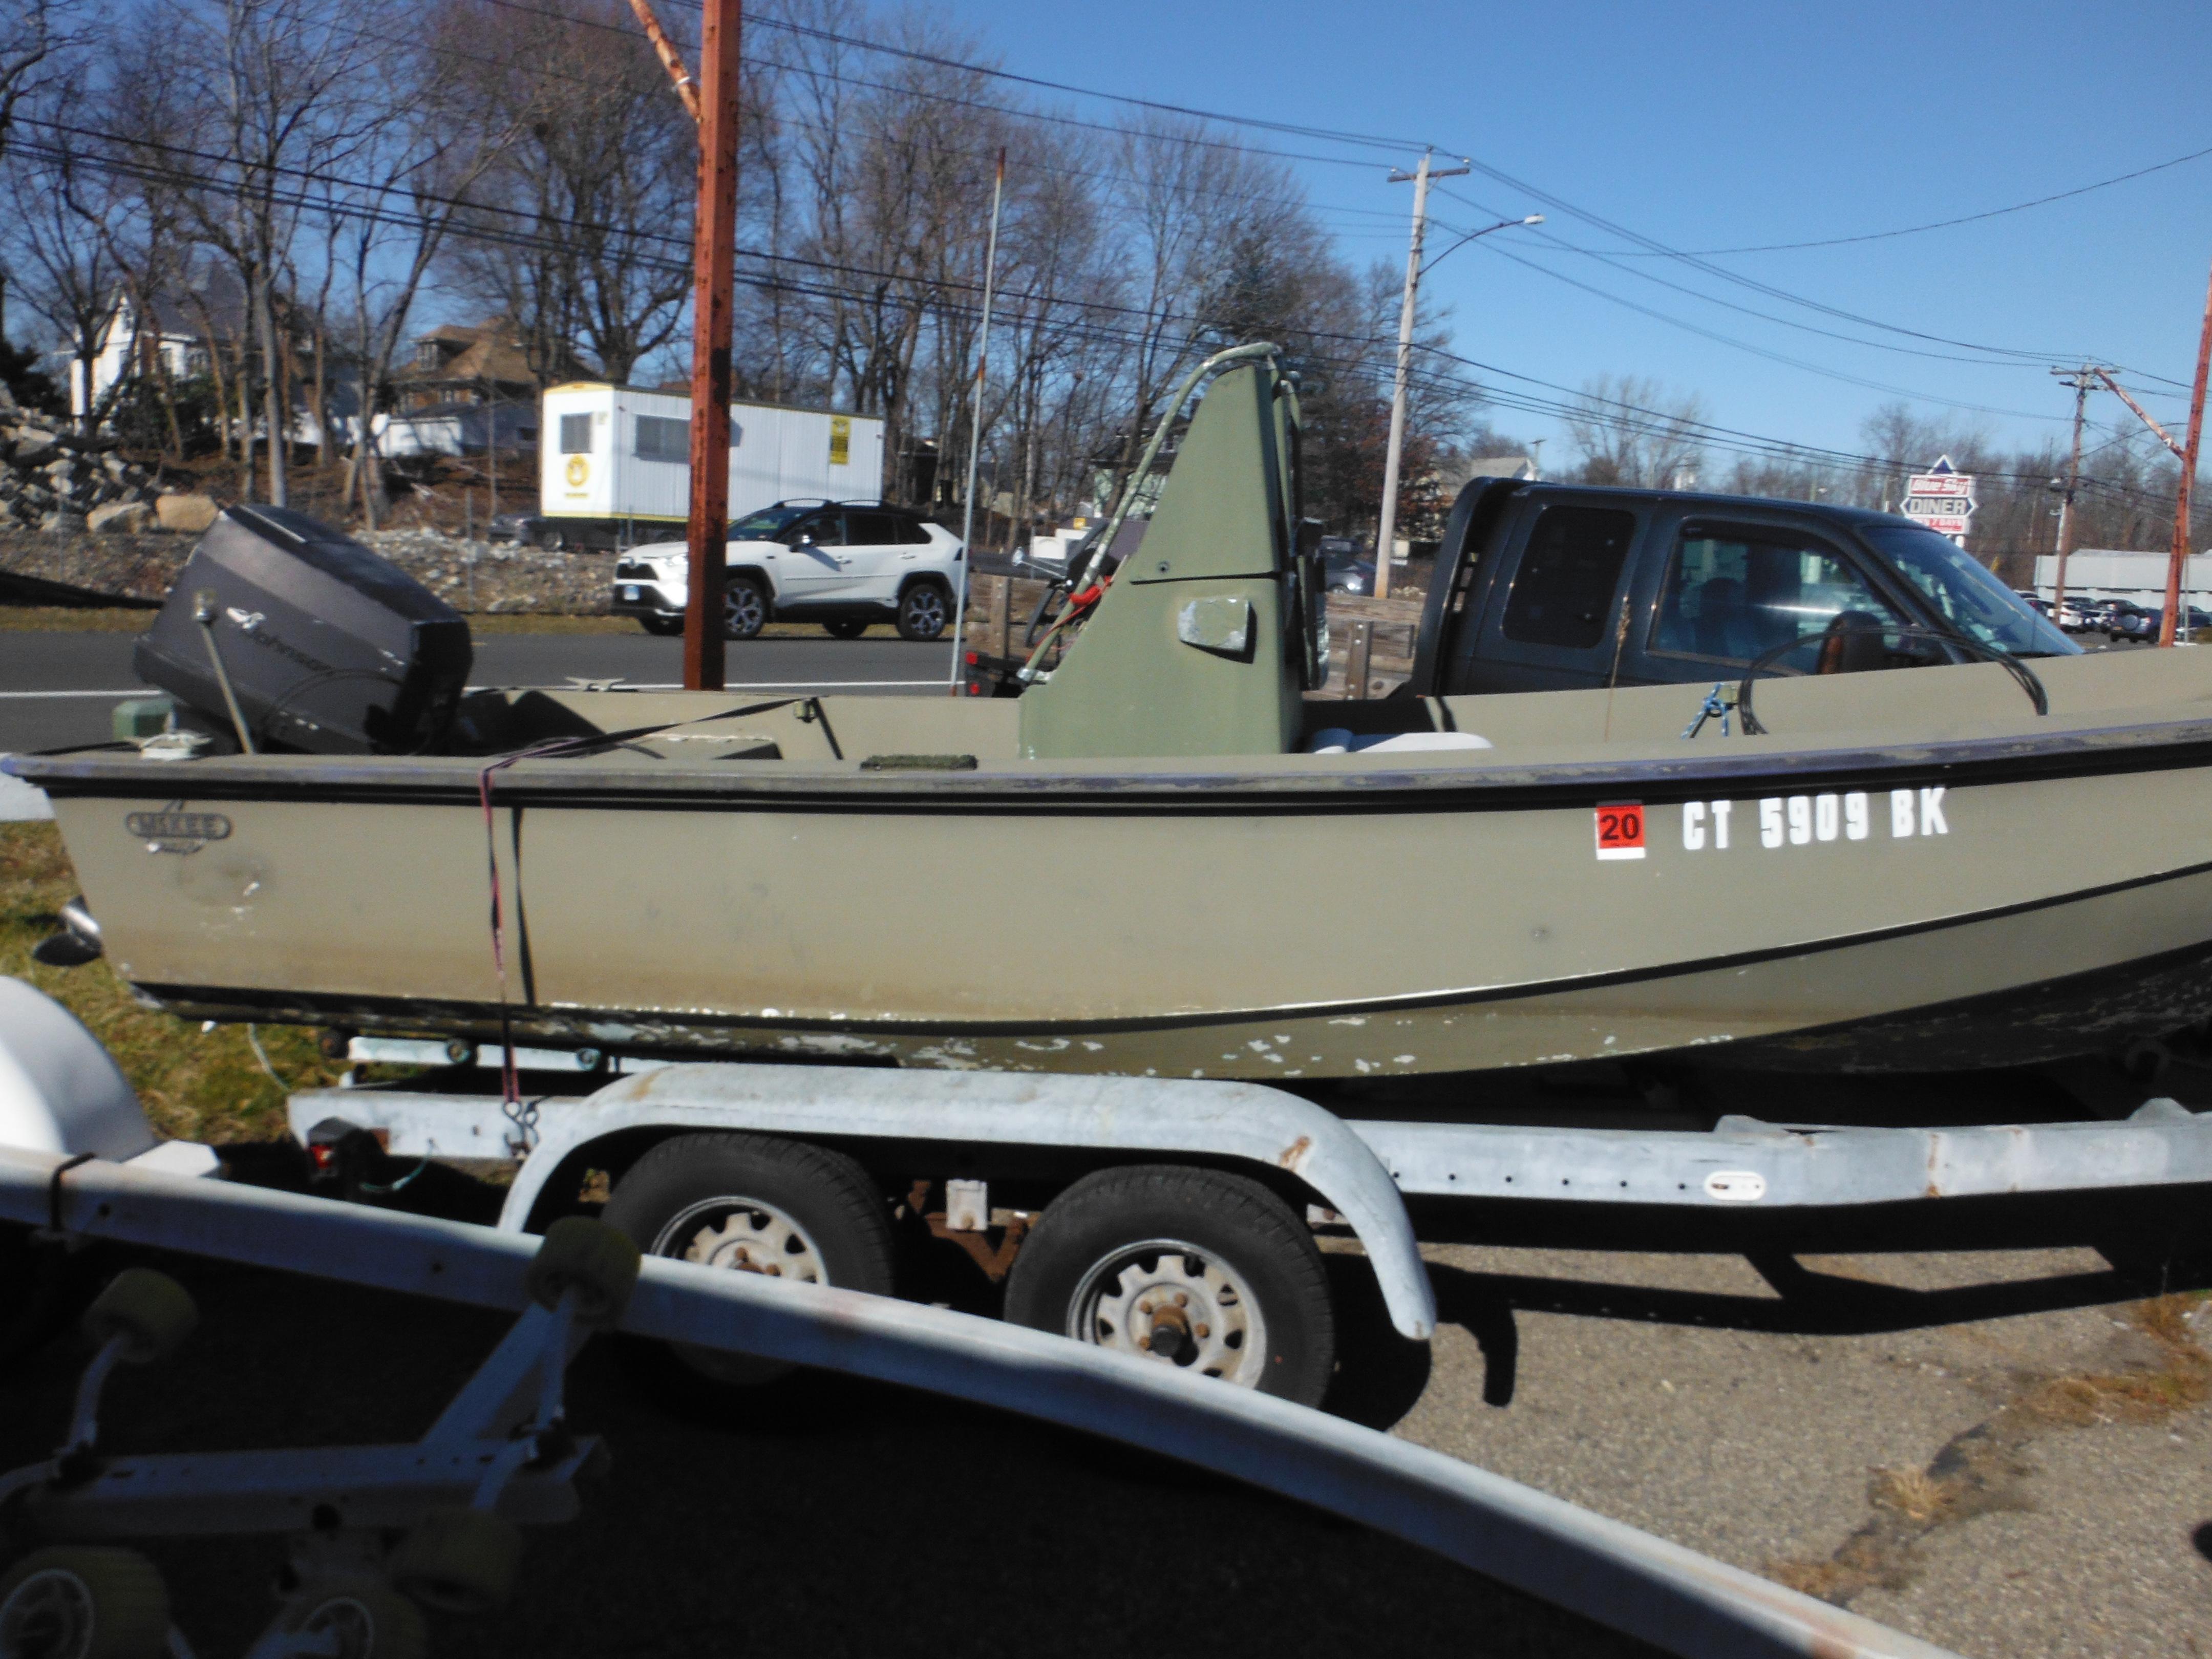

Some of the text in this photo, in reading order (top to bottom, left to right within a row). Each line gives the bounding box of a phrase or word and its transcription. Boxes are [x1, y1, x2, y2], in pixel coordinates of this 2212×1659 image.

[1909, 498, 1965, 515] DINER
[1600, 813, 1640, 841] 20
[1683, 787, 1947, 849] CT 5909 BK
